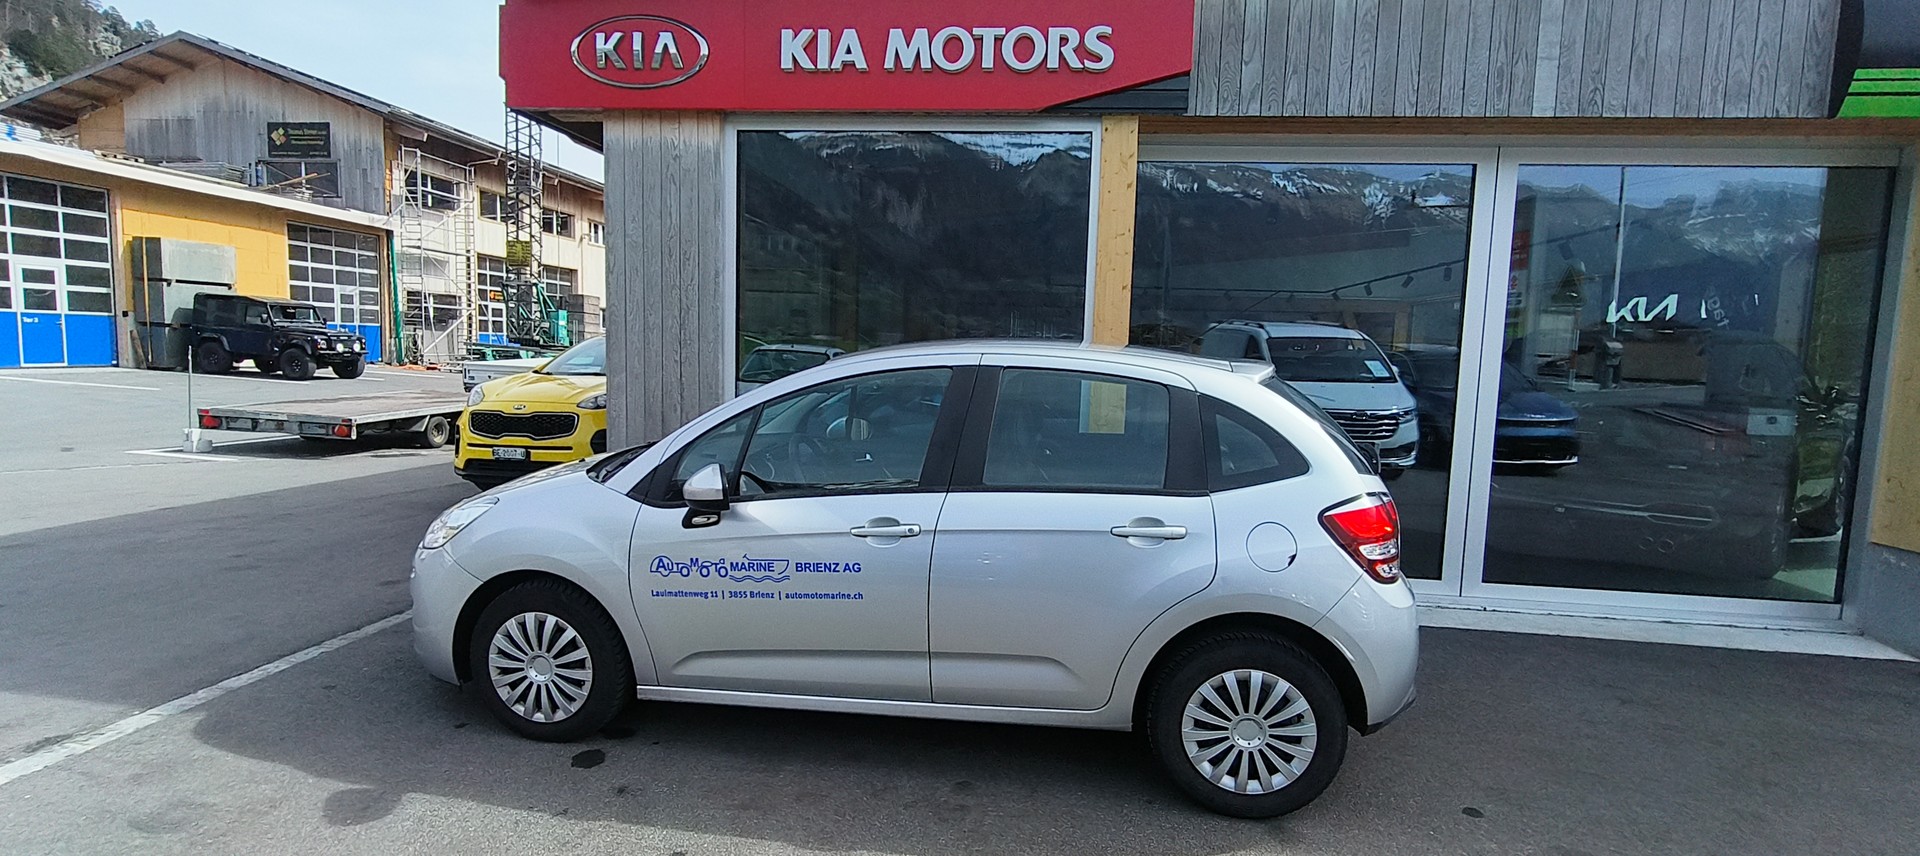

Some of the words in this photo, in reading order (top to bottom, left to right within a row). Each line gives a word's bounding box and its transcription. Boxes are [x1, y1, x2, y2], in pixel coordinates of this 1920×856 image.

[594, 31, 684, 69] KIA
[780, 28, 869, 72] KIA
[884, 25, 1115, 73] MOTORS
[730, 561, 775, 572] MARINE
[795, 562, 840, 573] BRIENZ
[843, 562, 862, 573] AG
[750, 591, 775, 599] Brienz
[785, 591, 864, 600] automotomarine.ch
